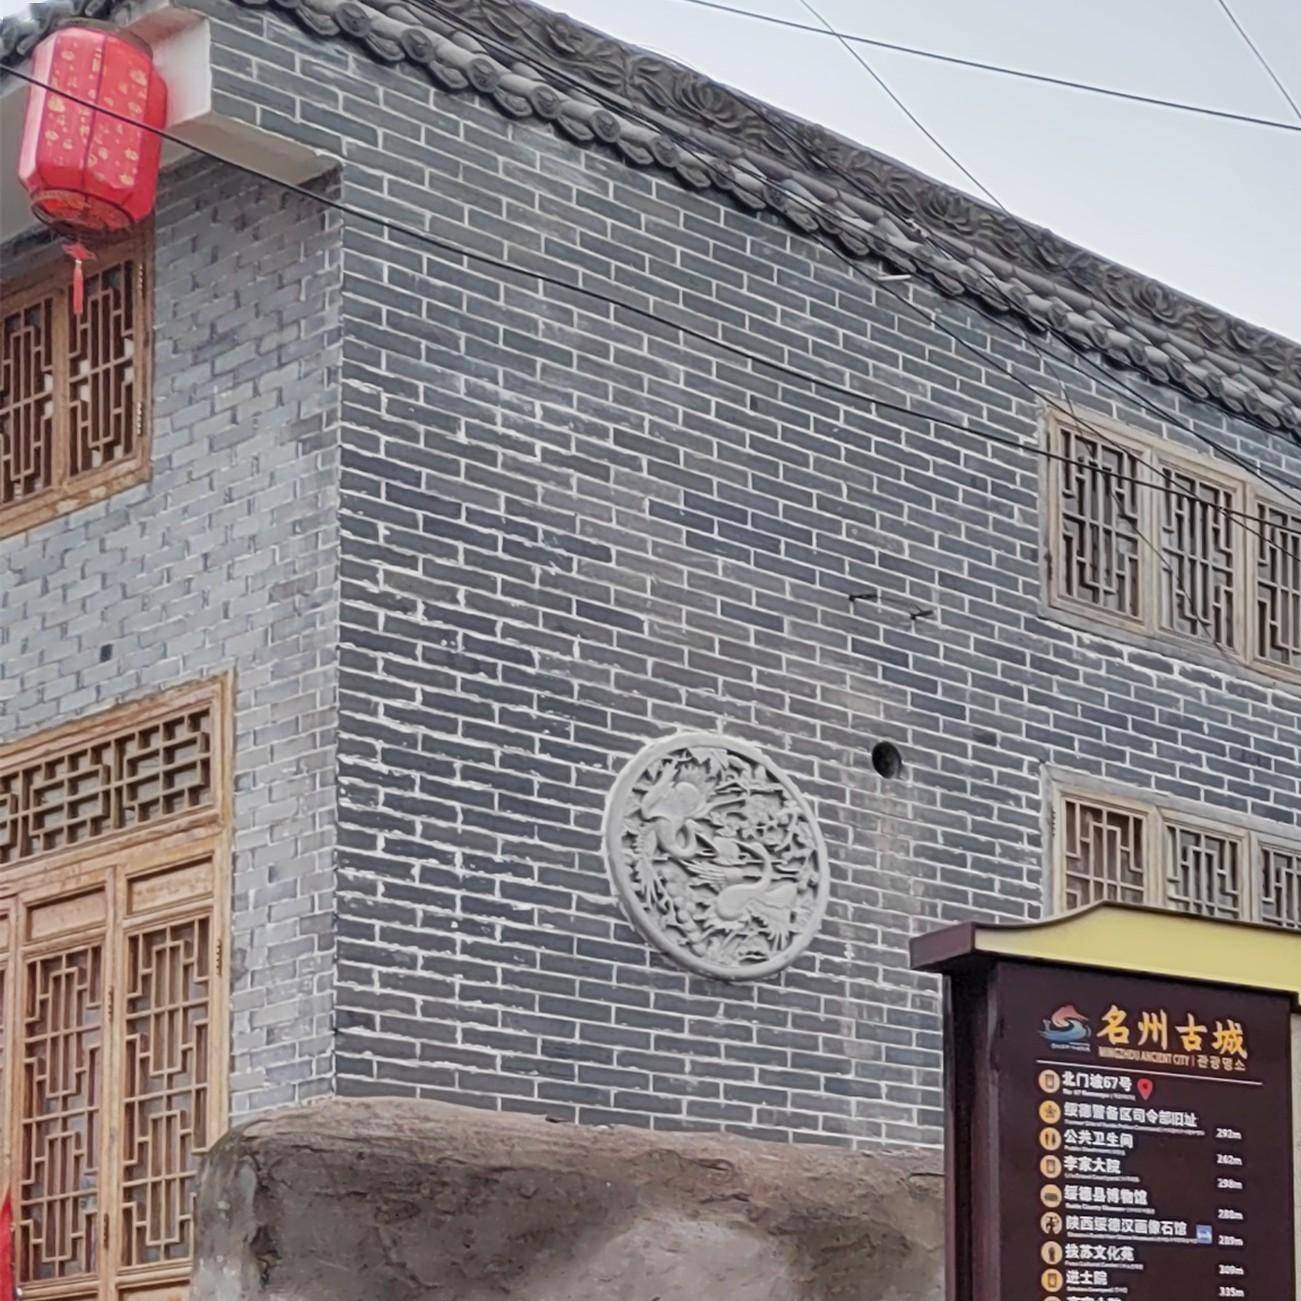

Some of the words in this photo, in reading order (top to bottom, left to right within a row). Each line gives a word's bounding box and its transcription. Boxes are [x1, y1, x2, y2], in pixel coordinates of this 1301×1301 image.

[1096, 1004, 1248, 1059] 名州古城
[1141, 1050, 1173, 1064] ANCIENT
[1173, 1053, 1190, 1066] CITY
[1063, 1129, 1134, 1149] 公共卫生间
[1063, 1184, 1148, 1205] 绥德县博物馆
[1065, 1215, 1188, 1236] 陕西绥德汉画像石馆
